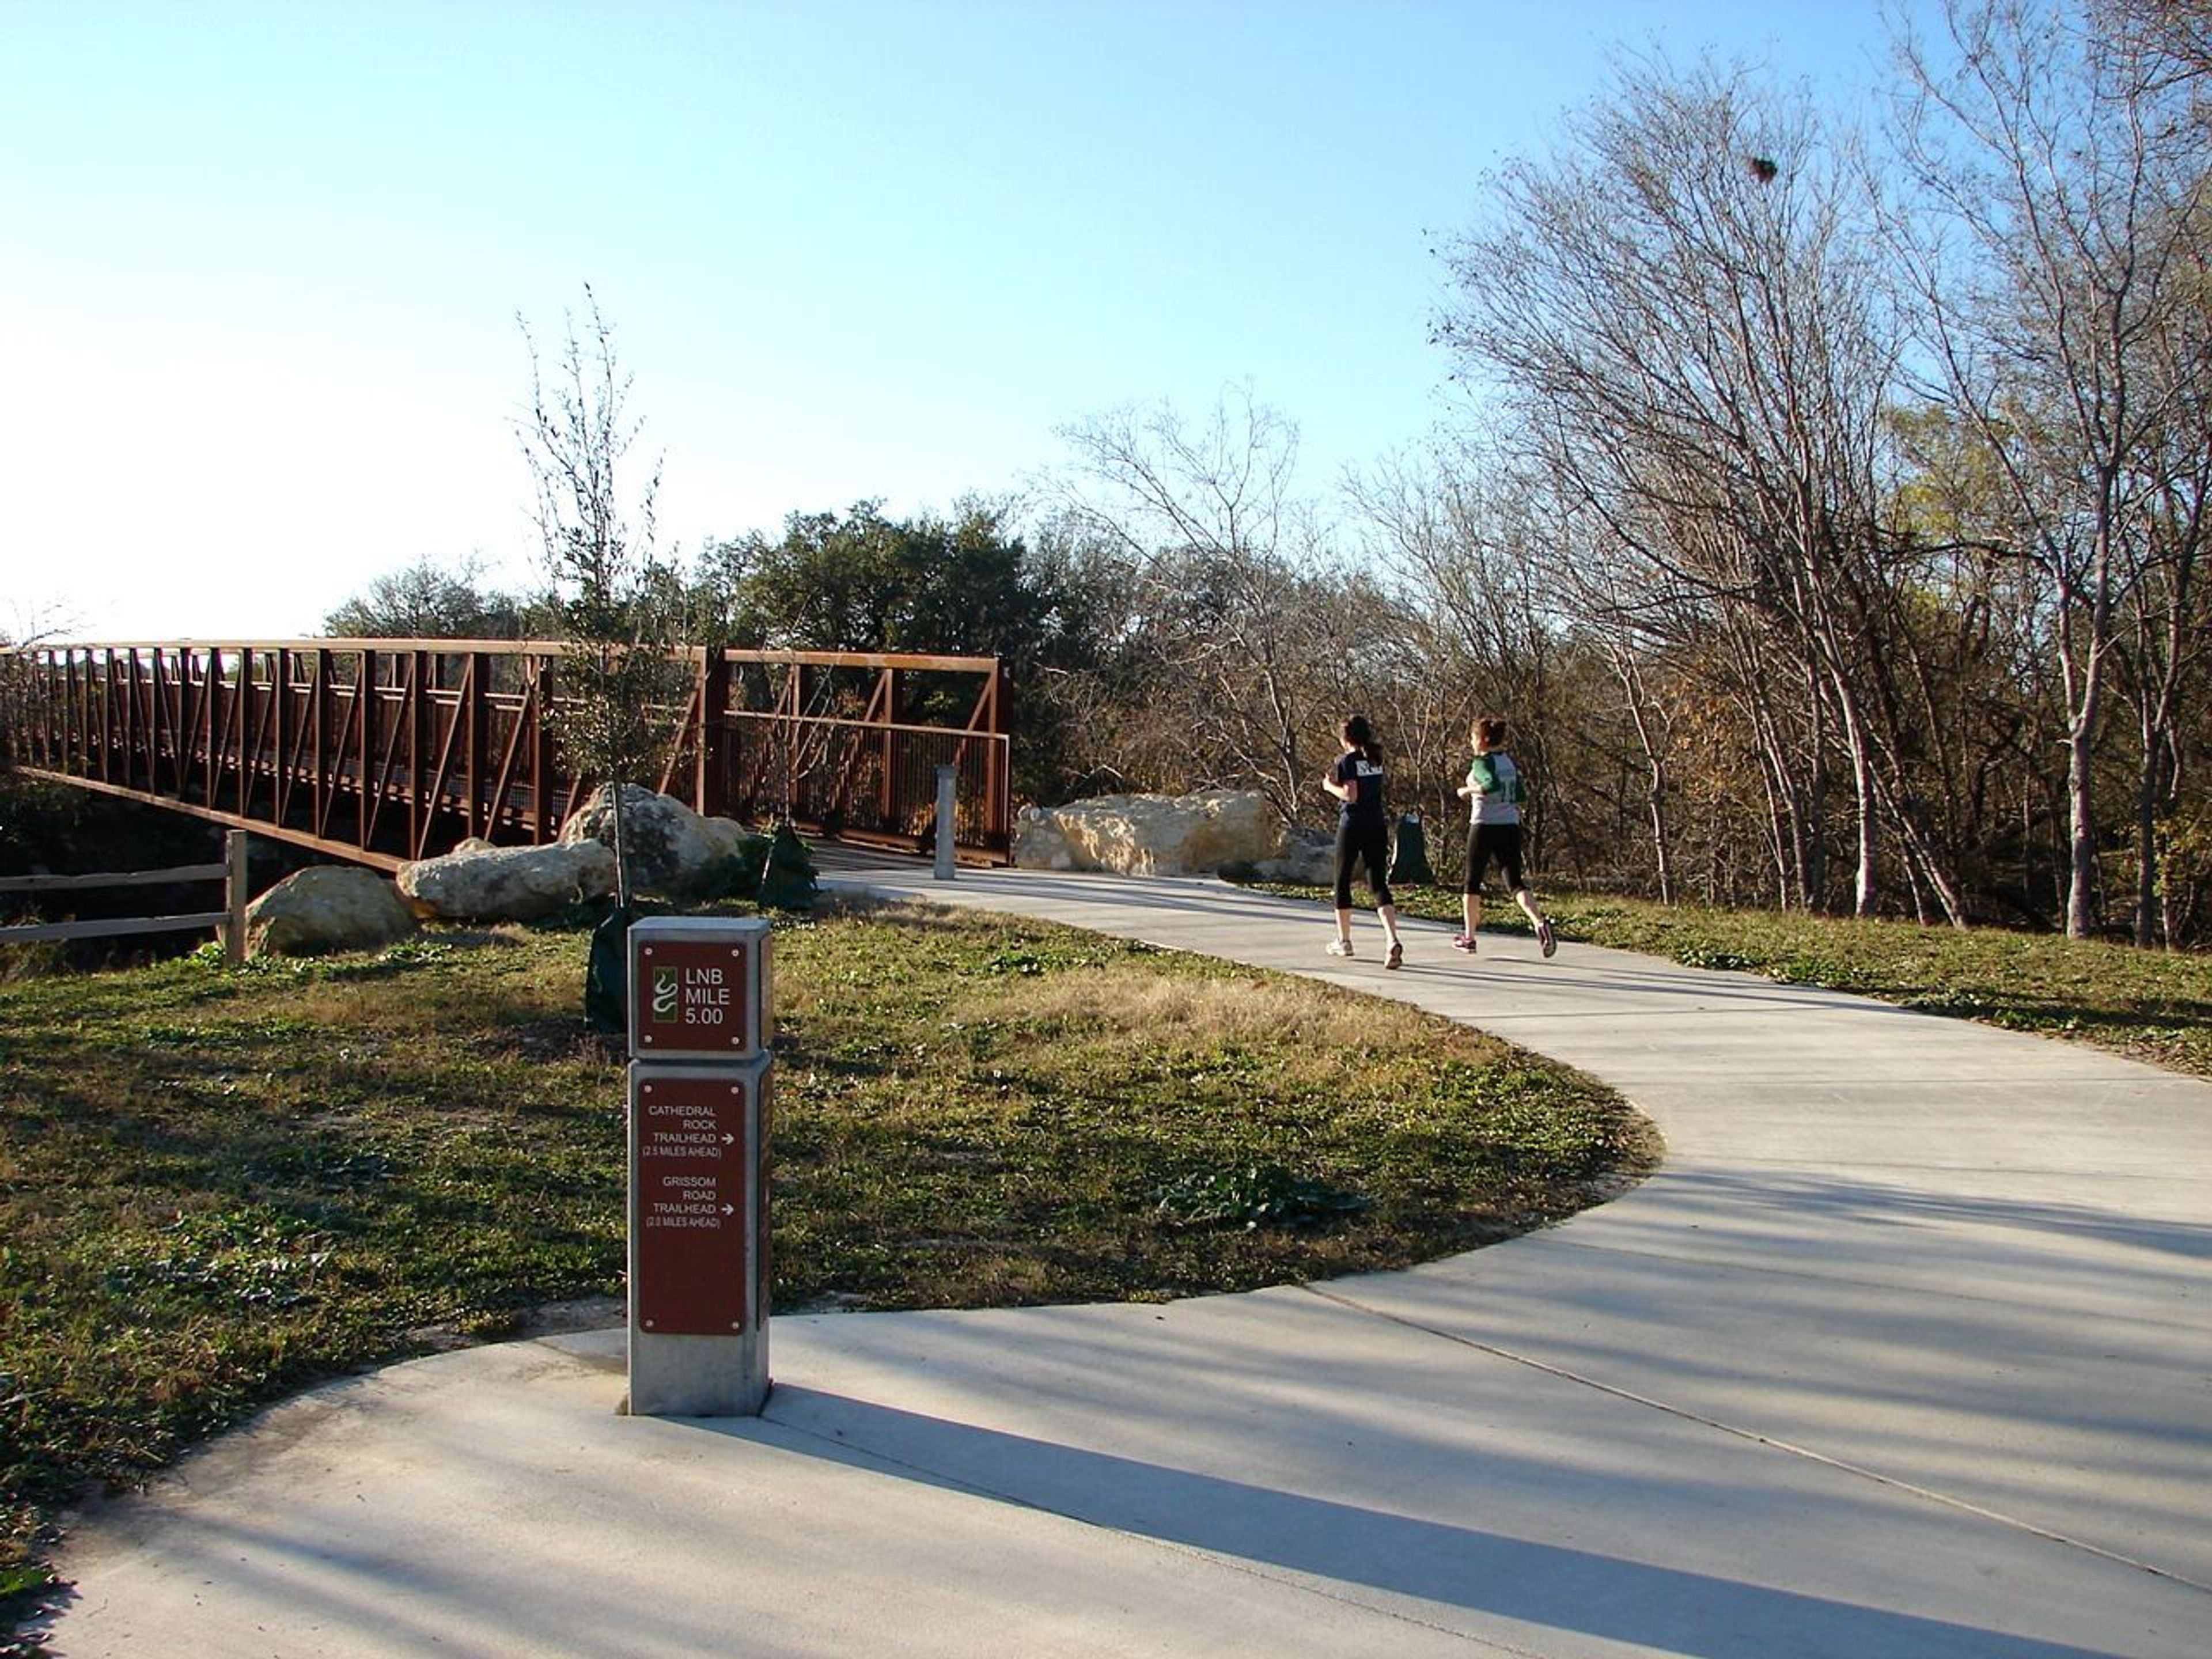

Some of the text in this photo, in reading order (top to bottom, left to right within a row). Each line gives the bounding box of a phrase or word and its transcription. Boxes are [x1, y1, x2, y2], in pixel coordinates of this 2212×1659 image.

[685, 968, 724, 984] LNB
[685, 988, 730, 1005] MILE
[685, 1008, 724, 1024] 5.00
[648, 1105, 716, 1116] CATHEDRAL
[683, 1120, 717, 1130] ROCK
[653, 1132, 717, 1143] TRAILHEAD
[660, 1146, 687, 1157] MILES
[688, 1146, 722, 1158] AHEAD)
[663, 1177, 717, 1187] GRISSOM
[683, 1191, 716, 1200] ROAD
[653, 1203, 717, 1214] TRAILHEAD
[663, 1217, 687, 1228] MILES
[689, 1217, 721, 1229] AHEAD)
